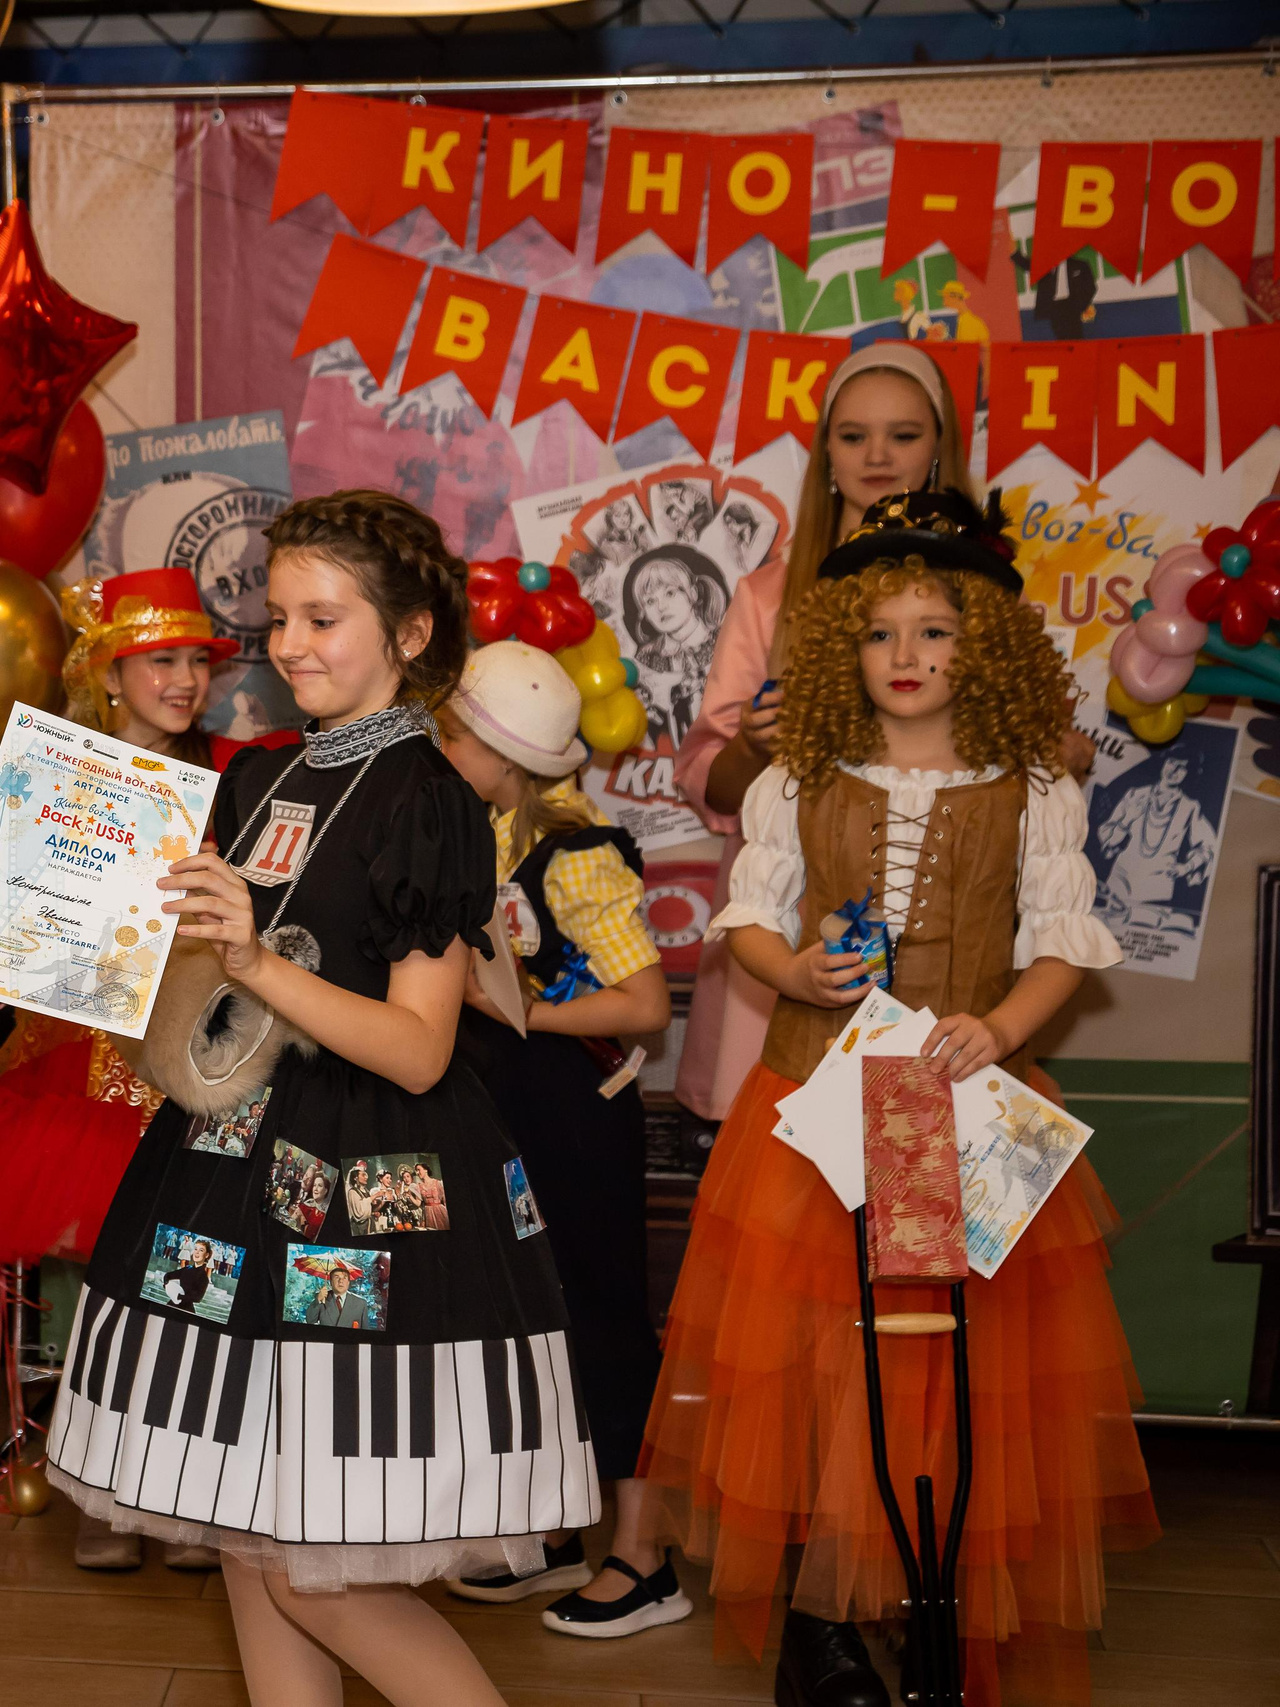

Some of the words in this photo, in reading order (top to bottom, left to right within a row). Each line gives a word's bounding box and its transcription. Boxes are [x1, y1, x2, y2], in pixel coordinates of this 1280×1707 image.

[401, 126, 791, 218] КИНО
[434, 295, 826, 423] BACK
[1022, 361, 1176, 430] IN
[1021, 501, 1160, 561] вог-ба
[216, 565, 269, 599] ВХО
[1061, 575, 1134, 626] US
[25, 752, 35, 760] от
[37, 755, 132, 793] театрально-творческой
[134, 791, 182, 810] мастерской
[46, 746, 54, 756] V
[55, 751, 123, 781] ЕЖЕГОДНЫЙ
[125, 776, 172, 797] ВОГ-БАЛ
[73, 780, 93, 791] ART
[95, 787, 130, 804] DANCE
[41, 804, 82, 831] Back
[84, 825, 93, 834] in
[96, 823, 135, 846] USSR
[45, 834, 116, 864] ДИПЛОМ
[51, 849, 103, 872] ПРИЗЁРА
[256, 824, 305, 874] 11
[48, 863, 102, 882] НАГРАЖДАЕТСЯ
[17, 927, 55, 941] категории
[33, 921, 44, 929] ЗА
[46, 923, 52, 931] 2
[54, 926, 81, 938] МЕСТО
